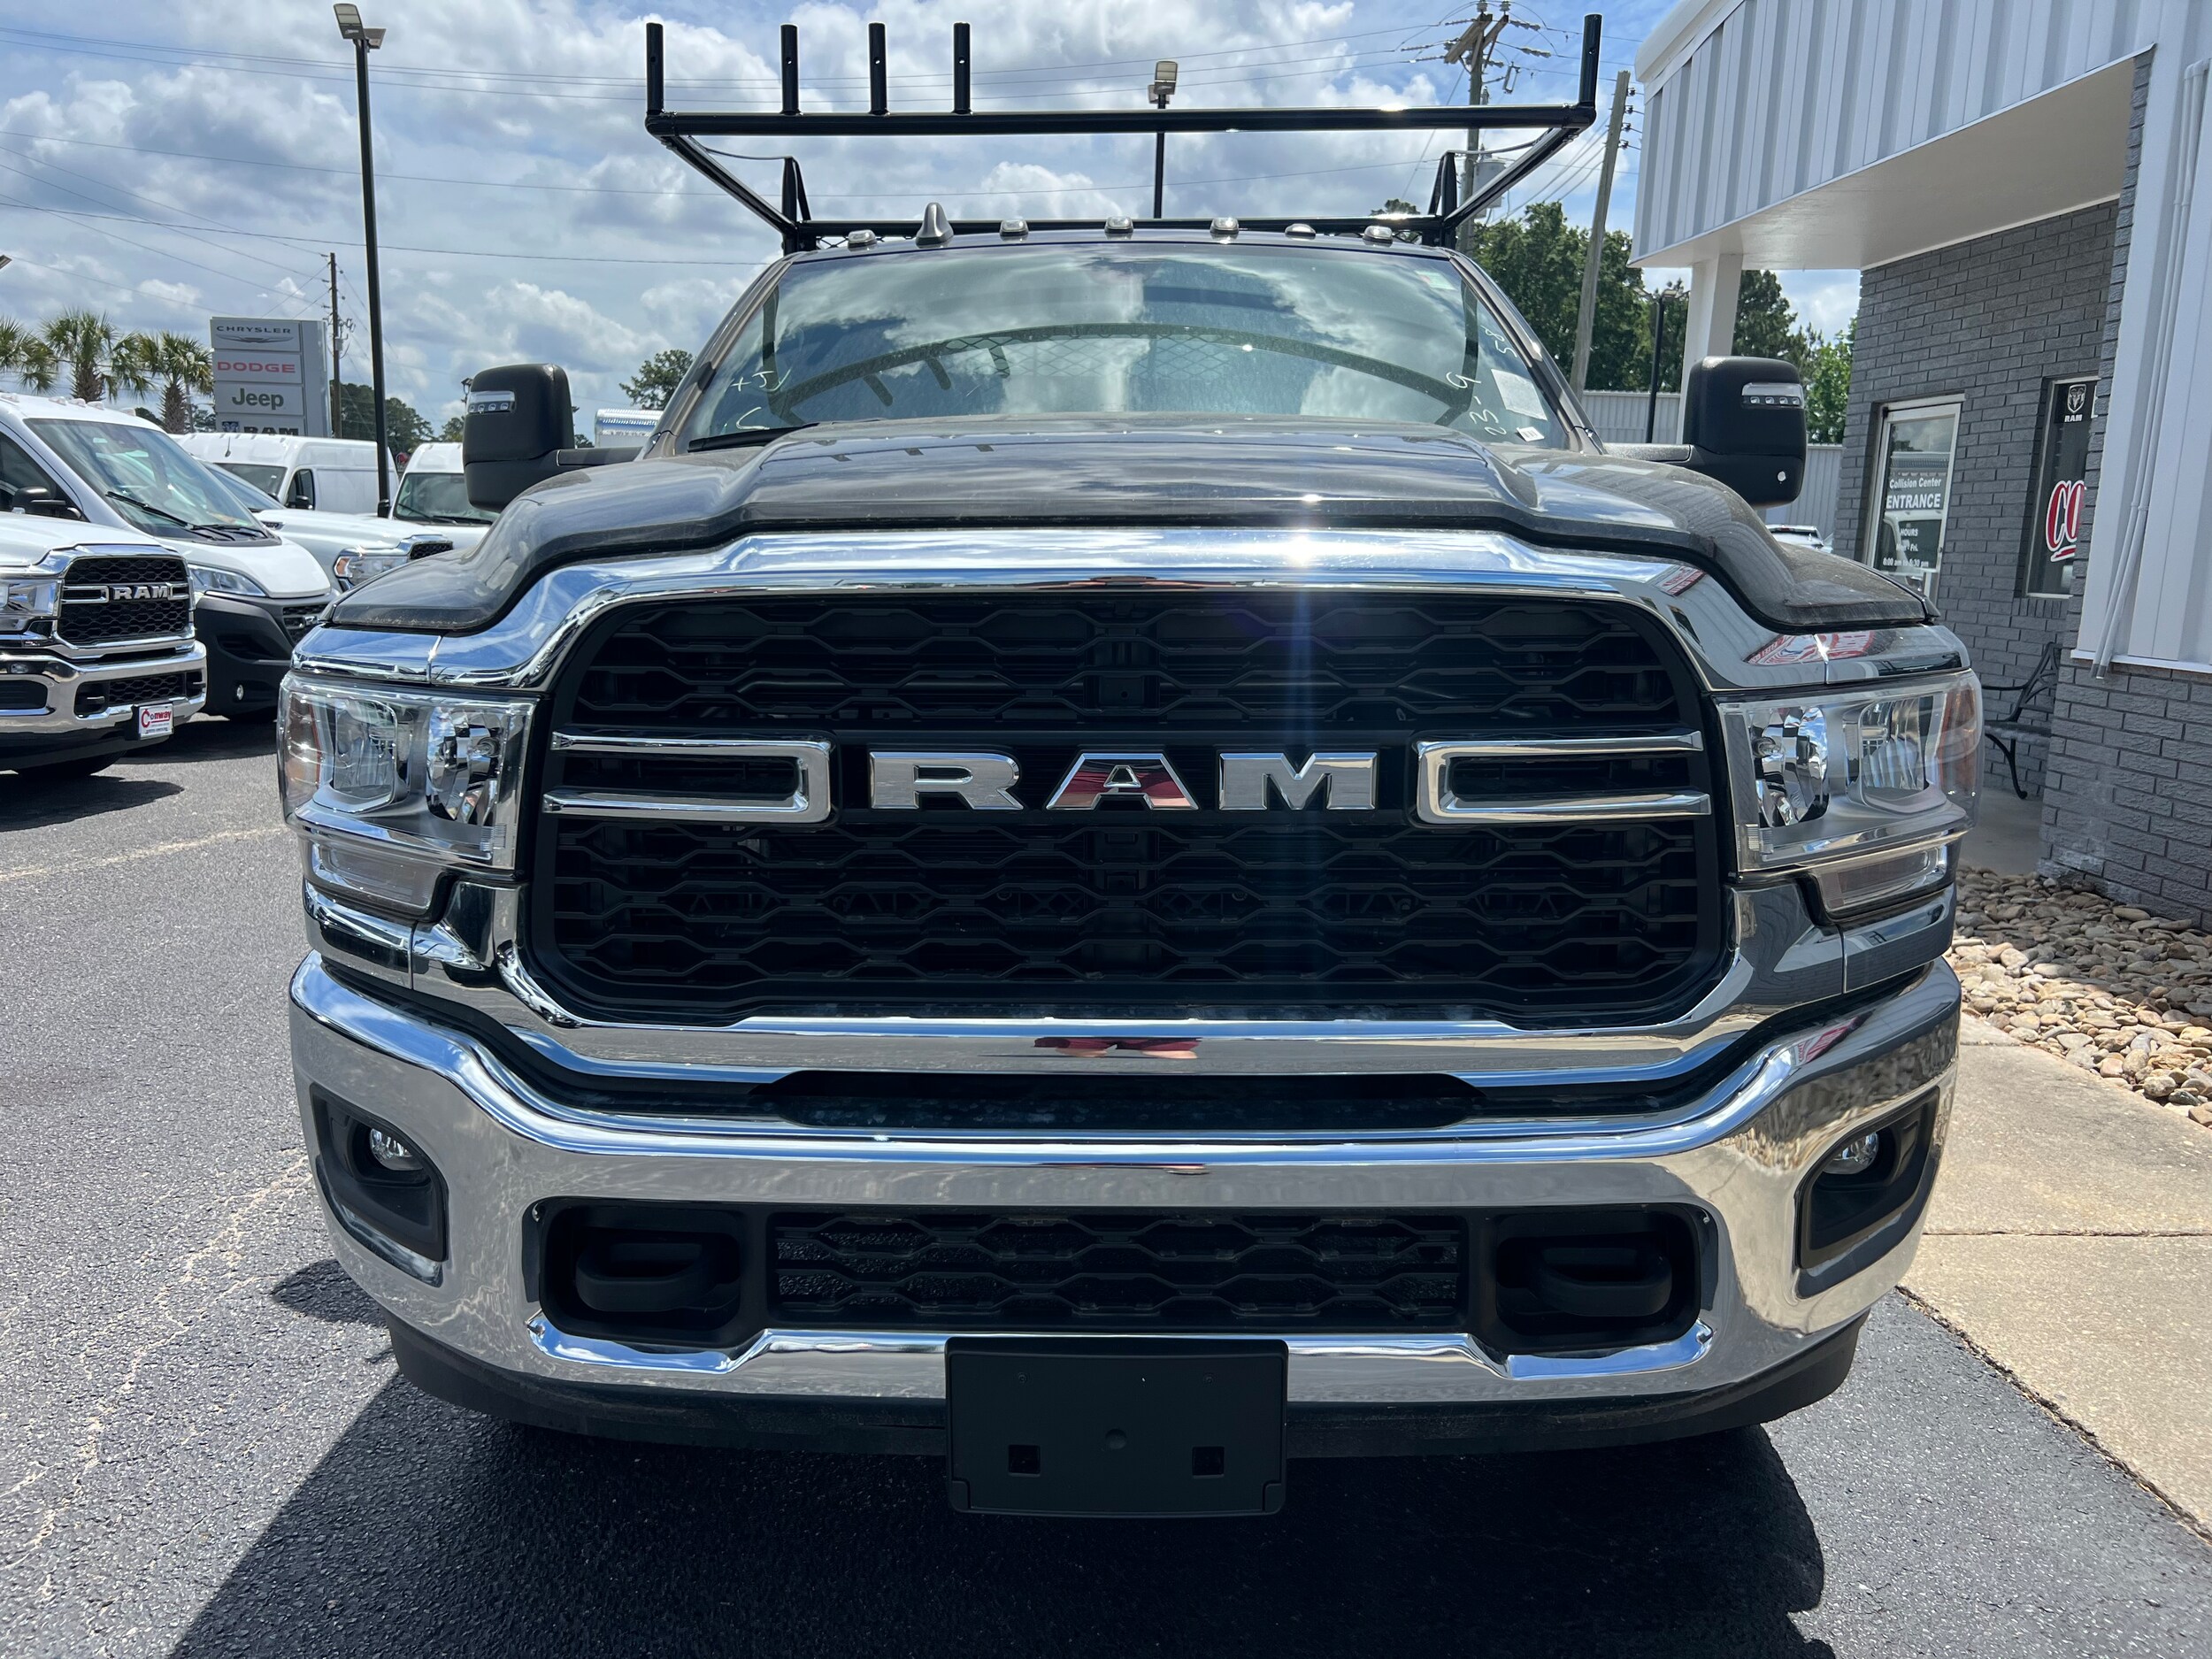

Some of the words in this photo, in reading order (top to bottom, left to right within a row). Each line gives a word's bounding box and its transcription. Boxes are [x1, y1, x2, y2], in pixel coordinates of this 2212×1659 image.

[216, 326, 291, 334] CHRYSLER
[217, 361, 296, 373] DODGE
[231, 388, 284, 411] Jeep
[2063, 414, 2083, 423] RAM
[1889, 478, 1917, 489] Collision
[1918, 477, 1942, 488] Center
[1886, 493, 1941, 509] ENTRANCE
[113, 585, 168, 600] RAM
[869, 751, 1378, 810] RAM
